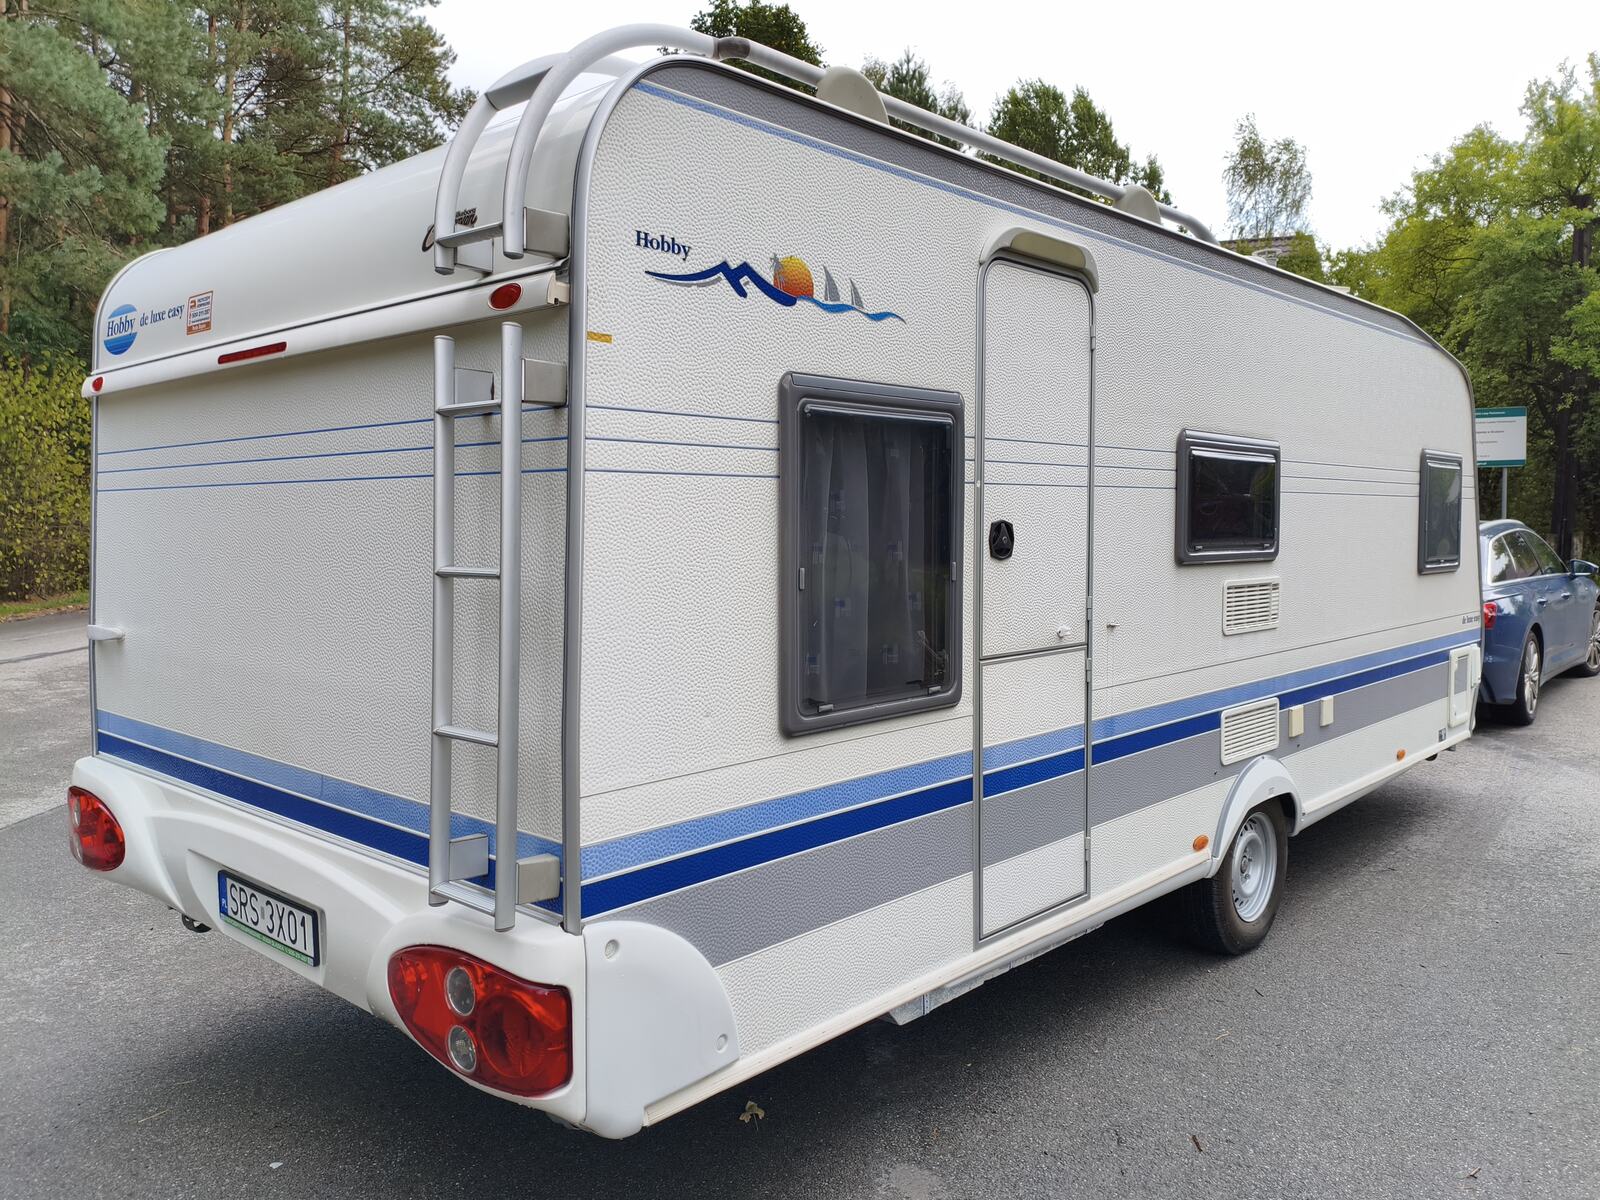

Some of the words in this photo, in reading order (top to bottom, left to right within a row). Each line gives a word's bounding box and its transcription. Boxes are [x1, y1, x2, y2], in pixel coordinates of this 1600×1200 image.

[635, 230, 691, 261] Hobby
[107, 315, 135, 338] Hobby
[140, 312, 149, 327] de
[150, 309, 166, 324] luxe
[167, 304, 185, 319] easy
[230, 883, 259, 926] SRS
[265, 900, 307, 951] 3X01
